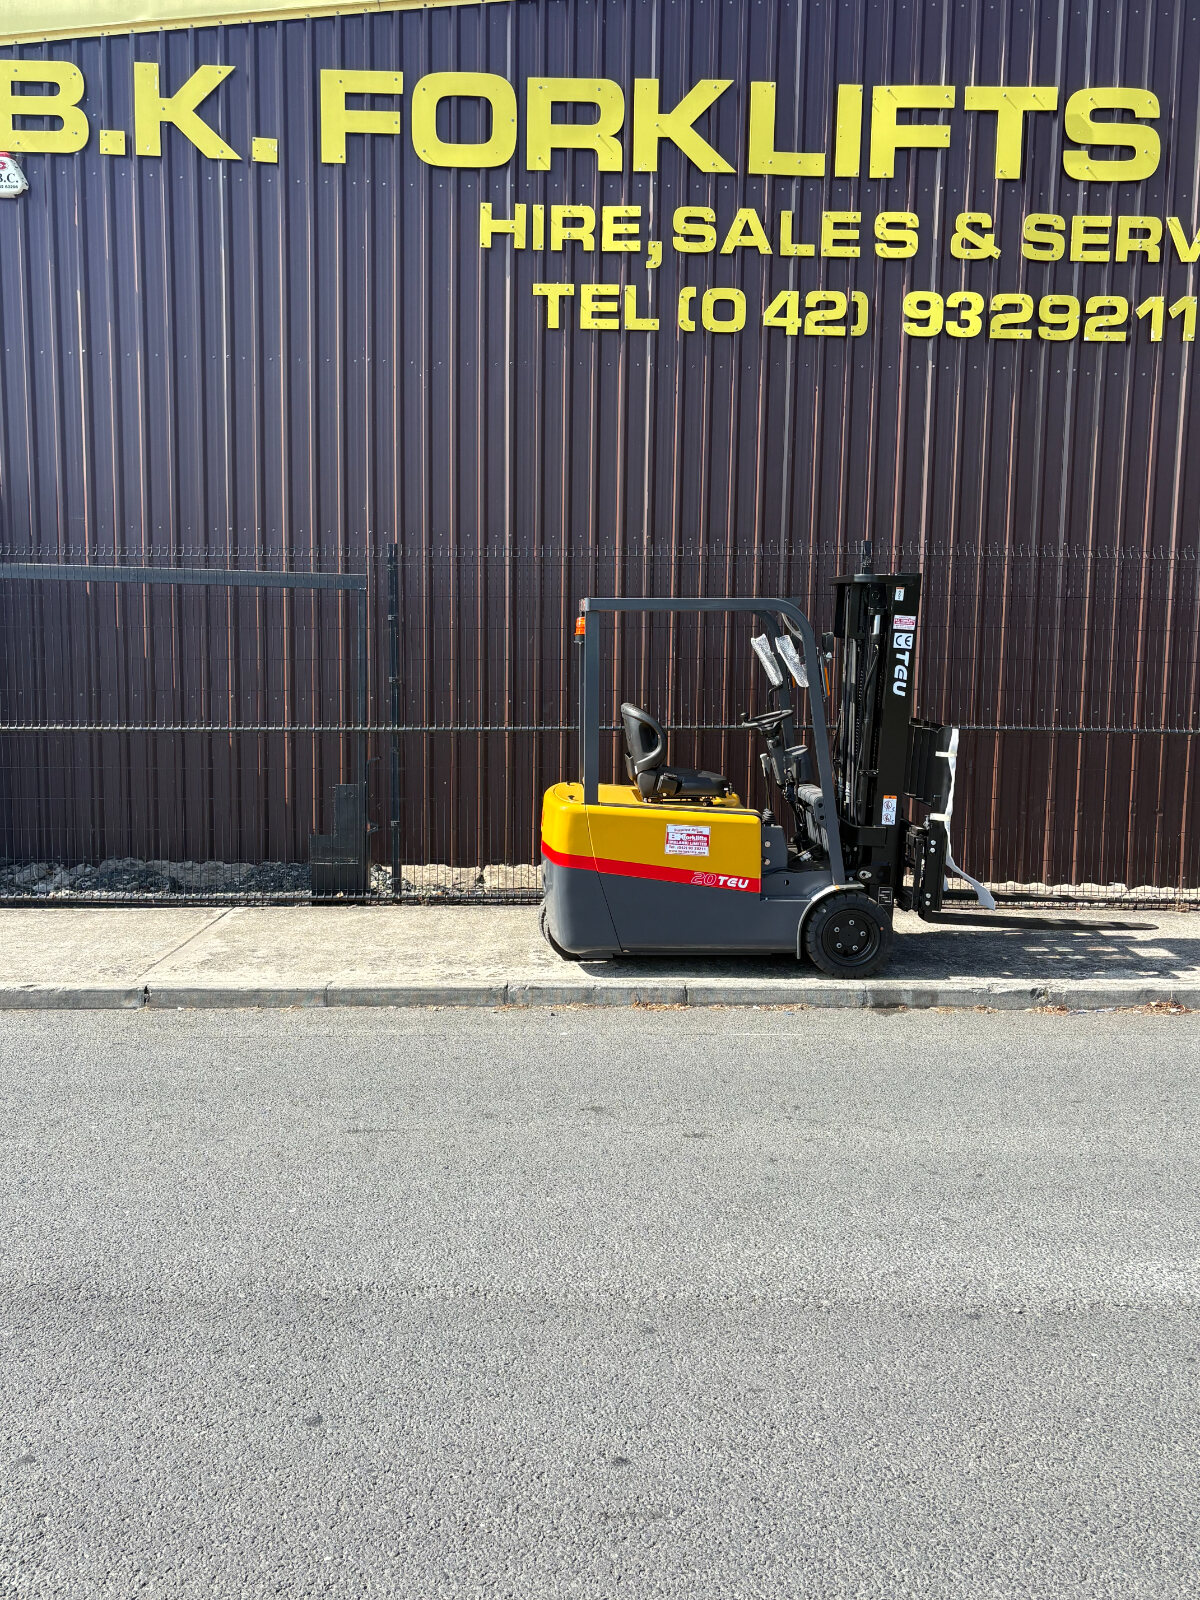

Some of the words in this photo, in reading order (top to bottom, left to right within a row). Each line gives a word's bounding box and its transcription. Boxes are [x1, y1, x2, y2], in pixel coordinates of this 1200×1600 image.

[0, 61, 277, 163] B.K.
[321, 69, 1160, 181] FORKLIFTS
[951, 212, 1000, 259] &
[533, 283, 659, 331] TEL
[903, 291, 1197, 341] 9329211
[893, 651, 909, 696] TEU
[691, 872, 716, 886] 20
[718, 876, 749, 889] TEU
